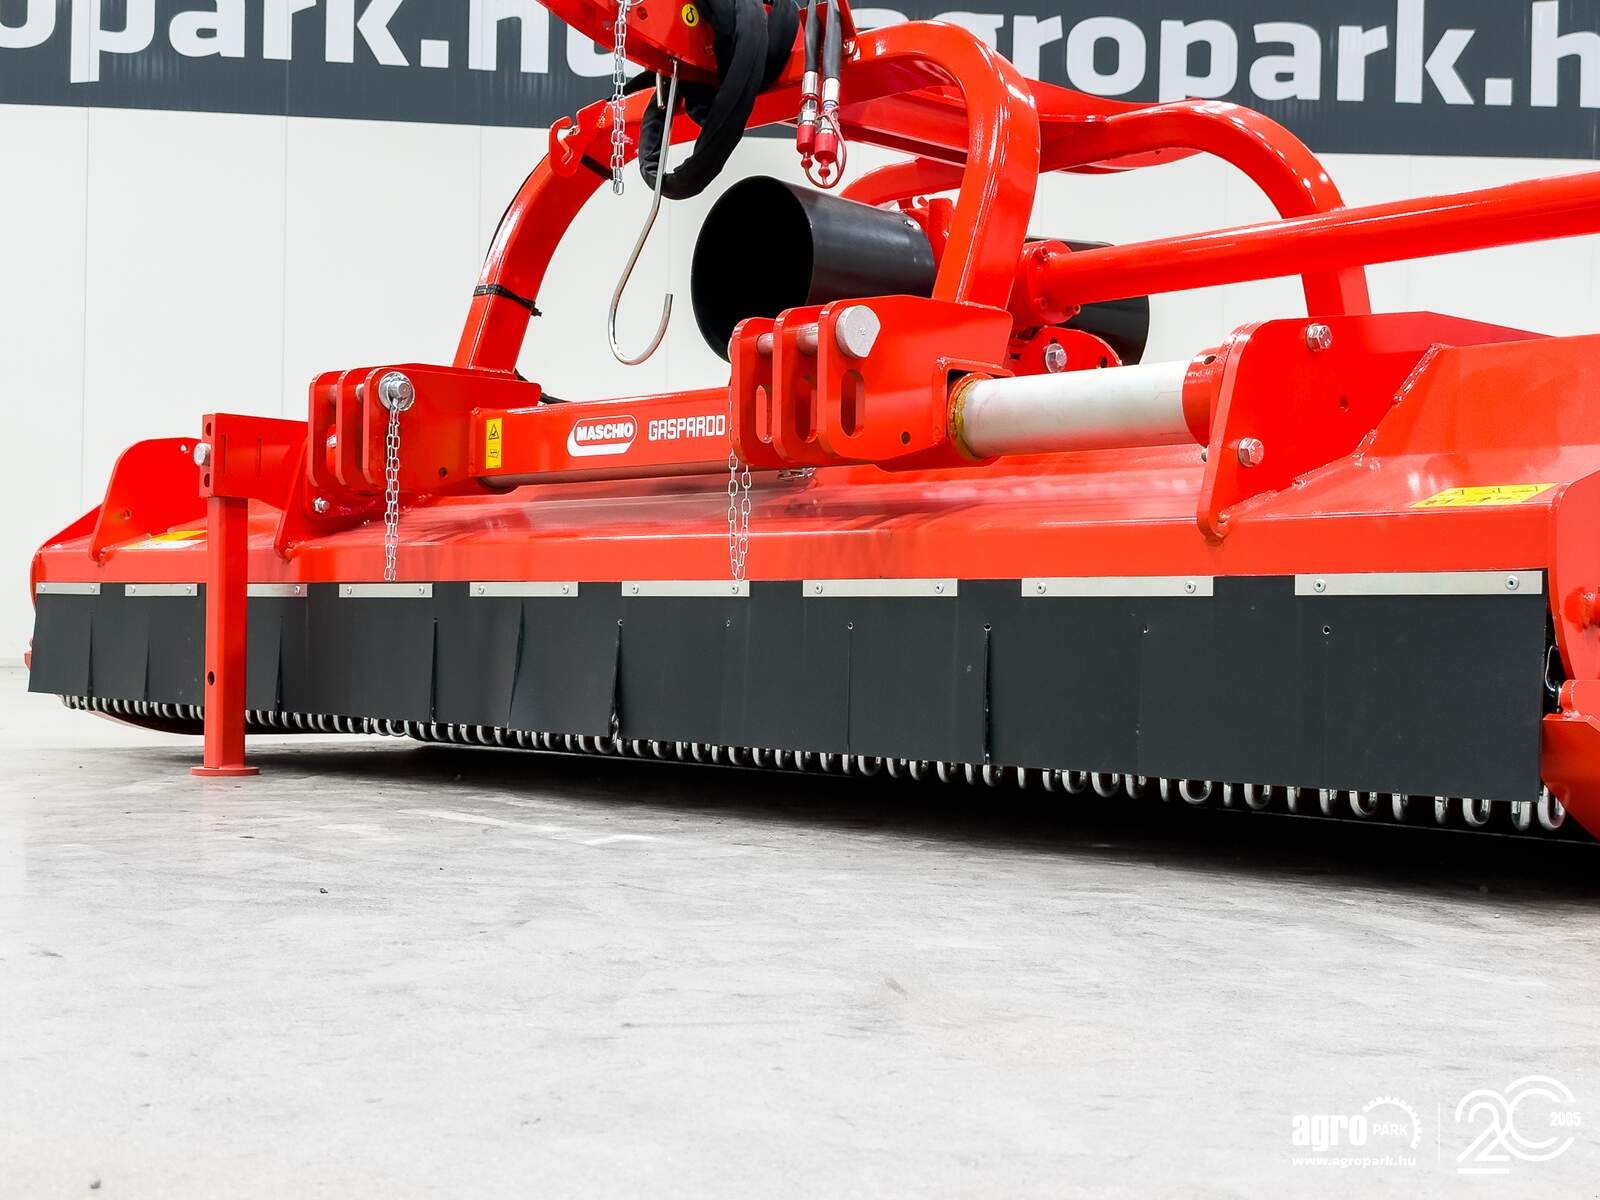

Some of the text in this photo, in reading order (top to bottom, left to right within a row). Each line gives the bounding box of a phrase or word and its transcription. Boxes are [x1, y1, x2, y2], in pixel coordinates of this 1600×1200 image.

[850, 0, 1600, 107] ropark.h
[576, 415, 726, 441] MASCHIO GASPARDO
